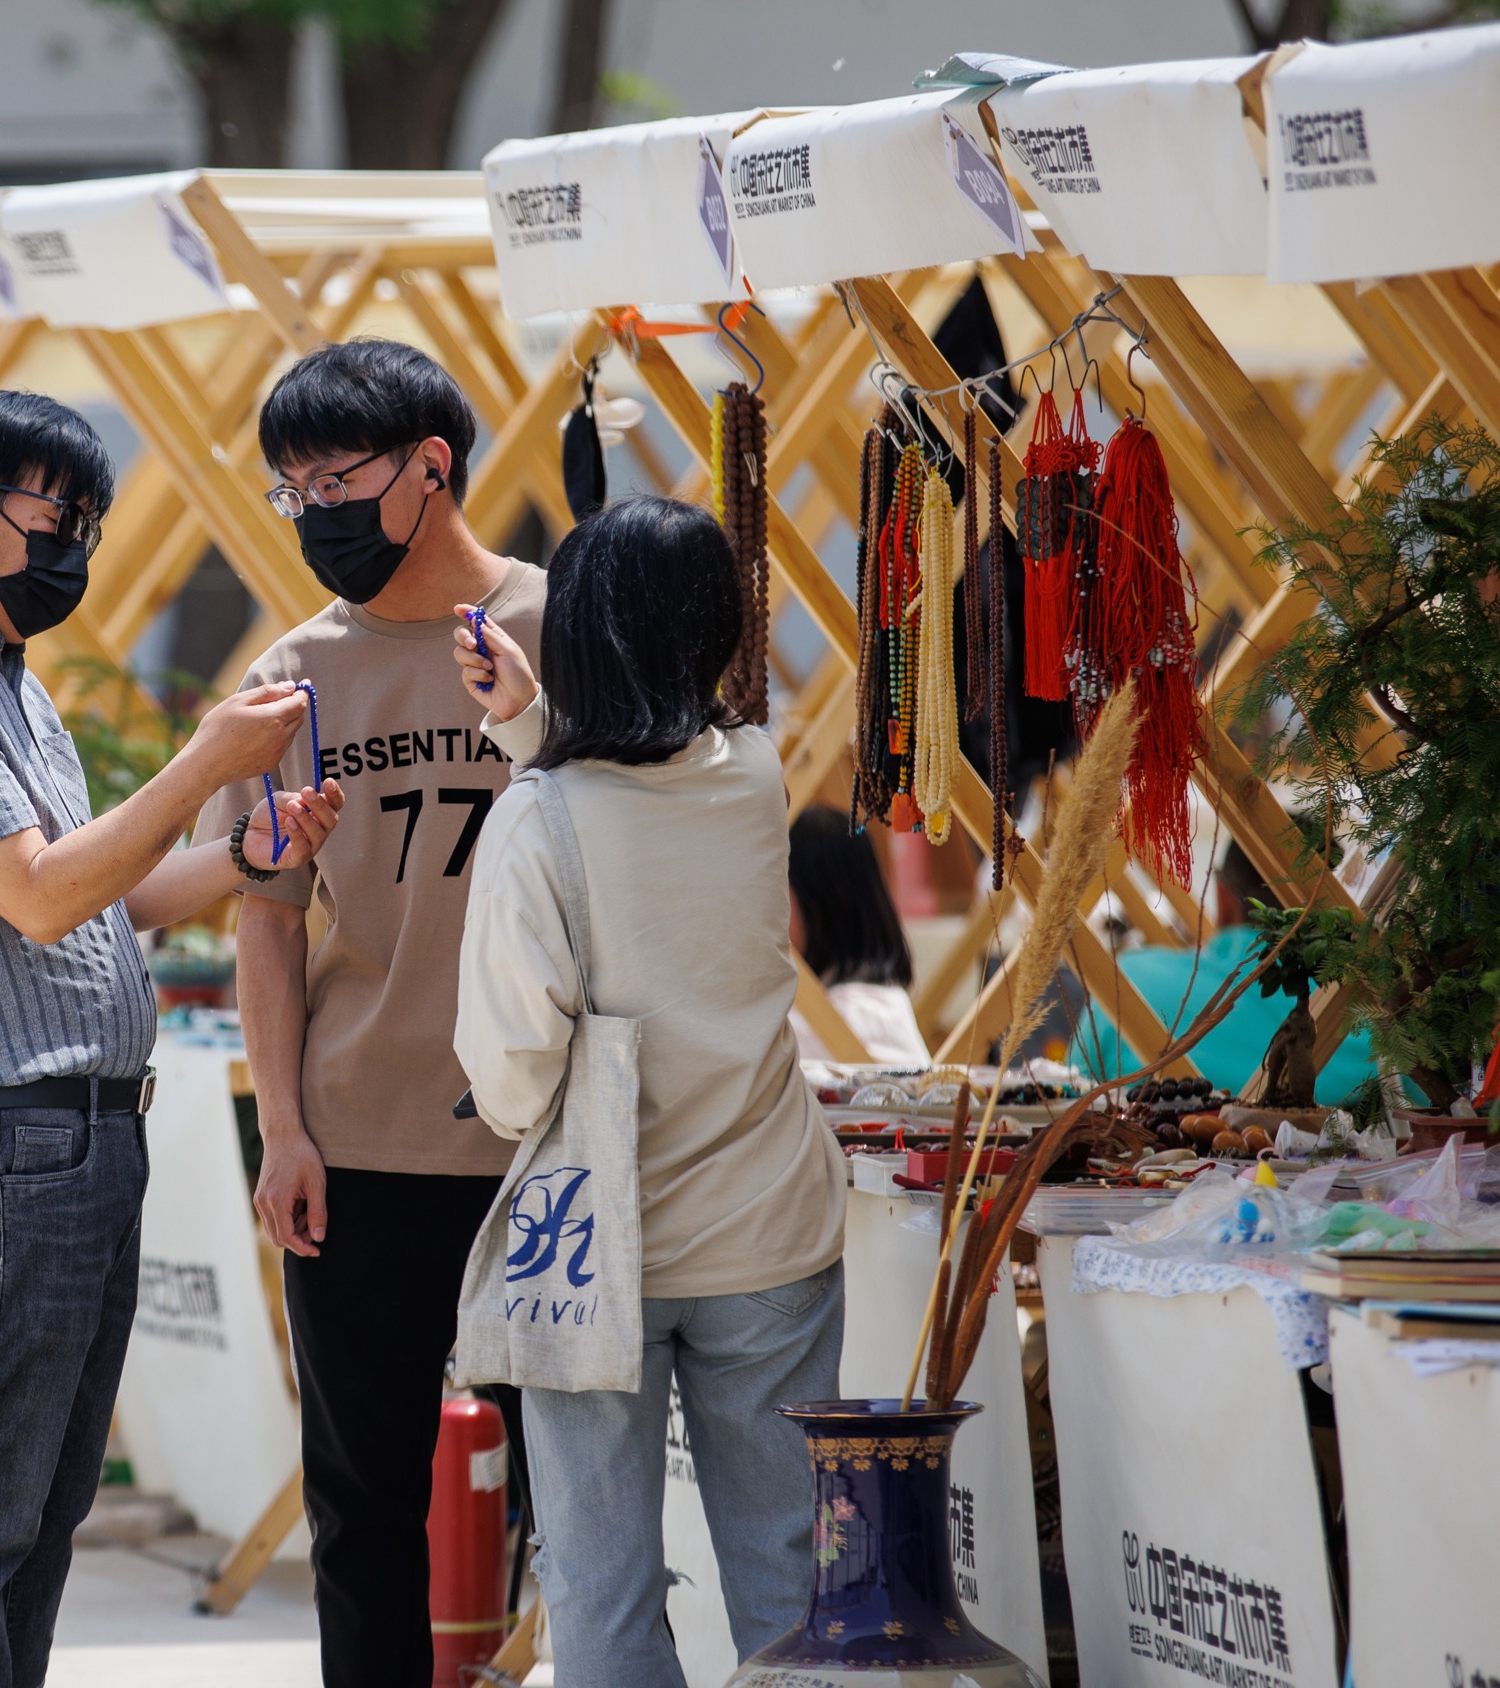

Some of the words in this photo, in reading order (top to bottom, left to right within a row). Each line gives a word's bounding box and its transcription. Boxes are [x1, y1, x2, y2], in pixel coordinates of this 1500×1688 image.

[740, 143, 812, 198] 中国宋庄艺术市集
[964, 169, 1005, 205] B094
[800, 192, 817, 208] CHINA
[320, 729, 513, 781] ESSENTIA
[380, 788, 493, 884] 77
[957, 1572, 979, 1606] CHINA
[1146, 1541, 1293, 1675] 中国宋庄艺术市集
[1155, 1633, 1211, 1680] SONGZHUANG
